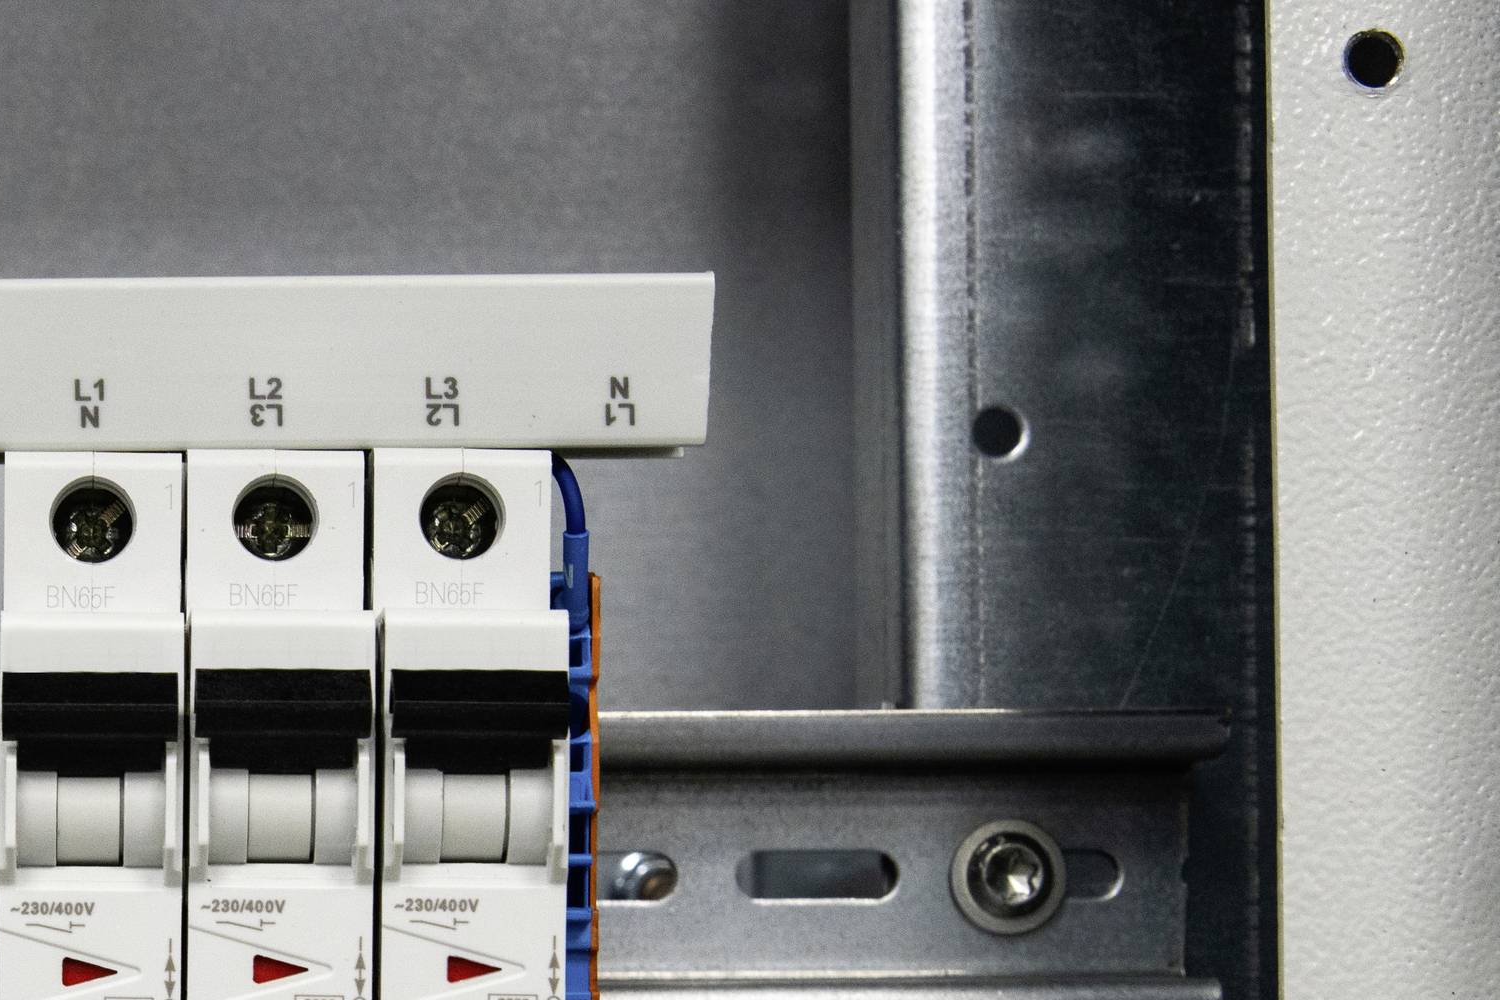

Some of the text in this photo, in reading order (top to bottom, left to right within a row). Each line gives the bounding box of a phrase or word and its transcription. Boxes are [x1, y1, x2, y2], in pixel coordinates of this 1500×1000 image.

[74, 379, 105, 402] L1
[249, 377, 282, 400] L2
[425, 376, 459, 400] L3
[611, 376, 629, 399] N
[81, 406, 100, 428] N
[250, 404, 283, 427] L3
[426, 403, 460, 427] L2
[605, 402, 635, 427] L1
